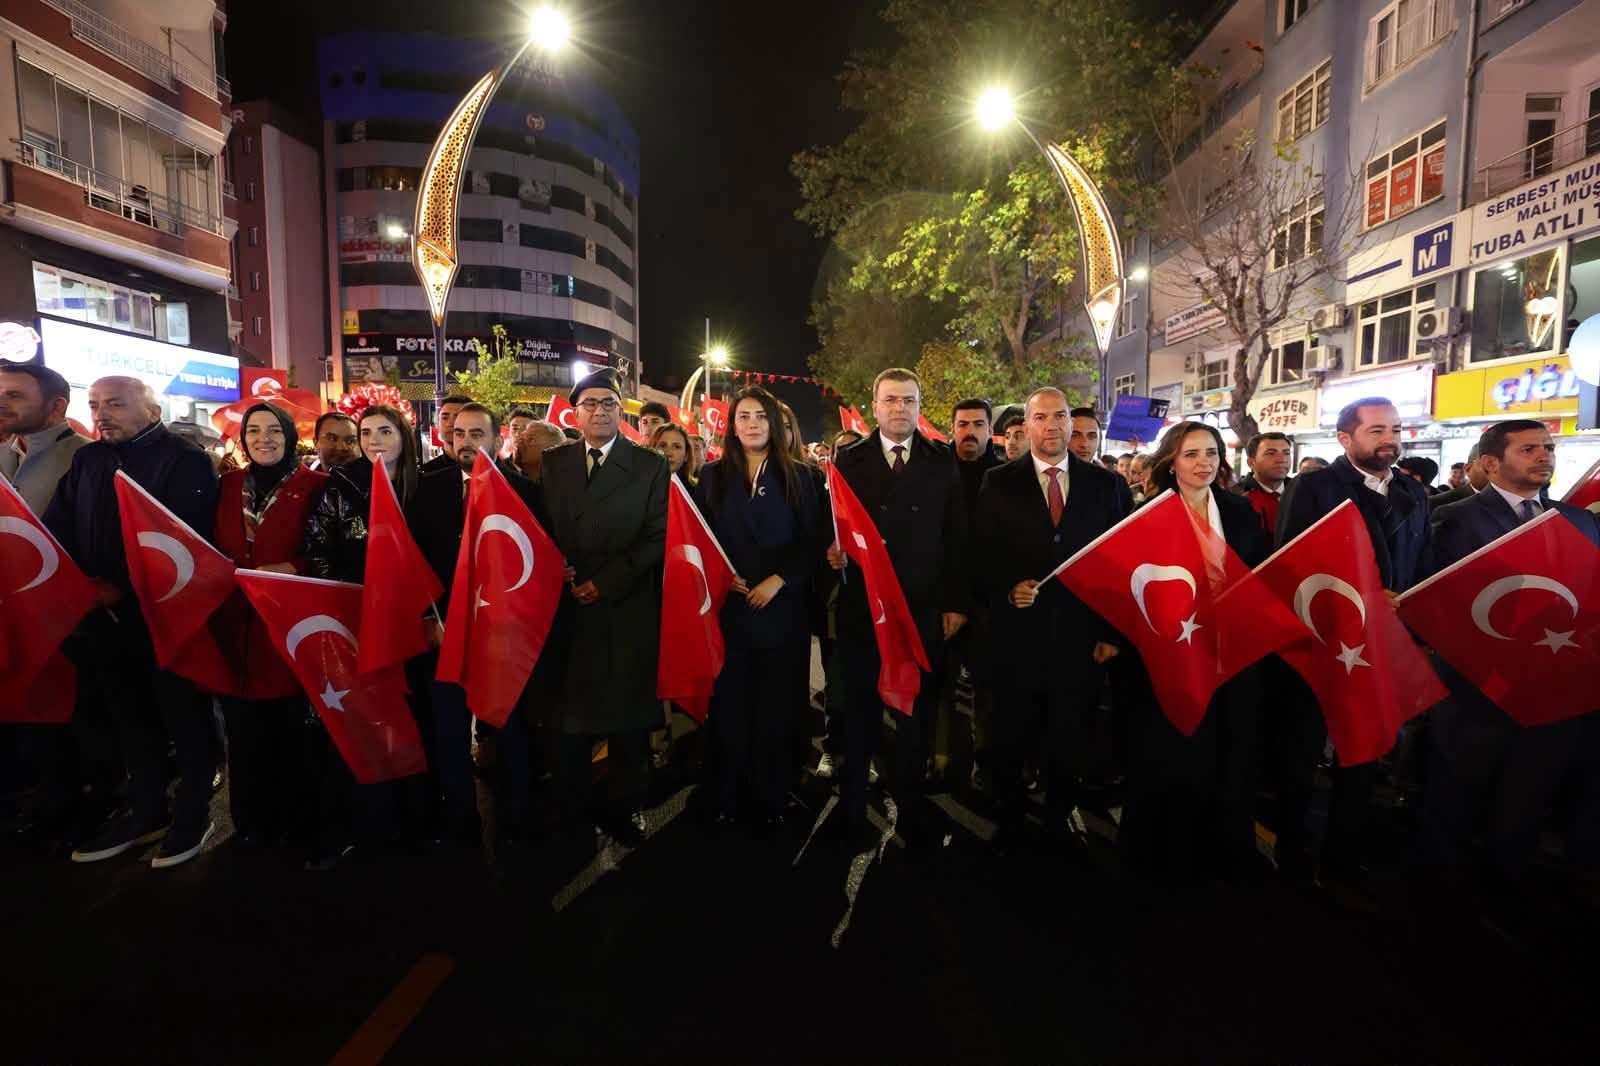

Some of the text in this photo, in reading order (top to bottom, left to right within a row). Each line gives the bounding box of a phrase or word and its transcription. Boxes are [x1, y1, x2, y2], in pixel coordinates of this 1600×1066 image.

[1486, 179, 1560, 218] SERBEST
[1472, 228, 1526, 259] TUBA
[1532, 207, 1584, 241] ATLI
